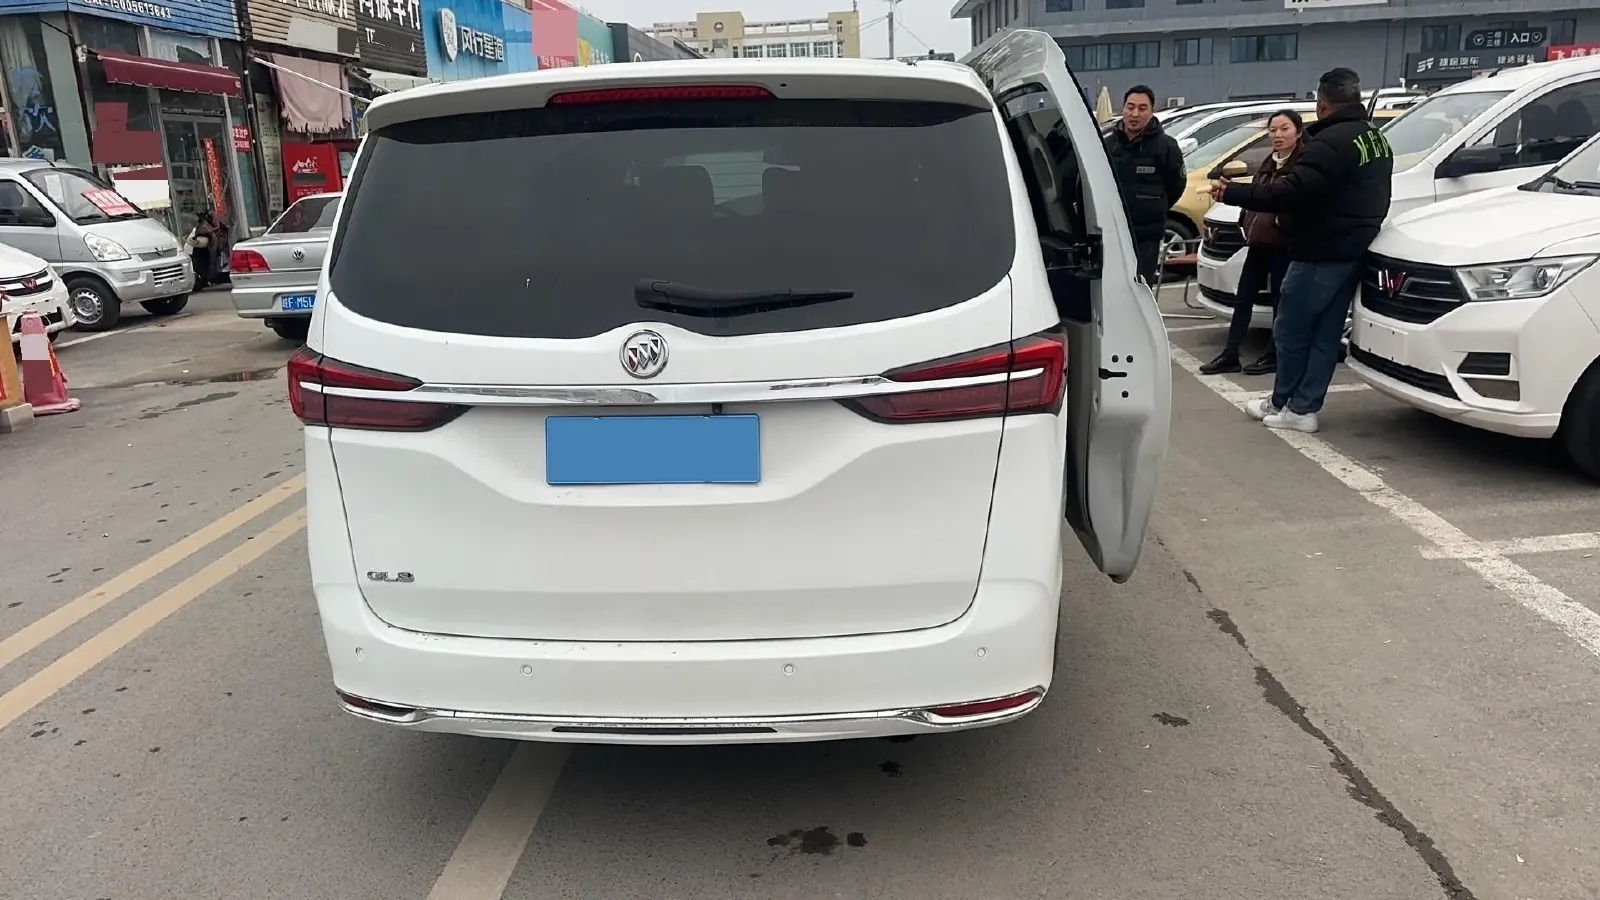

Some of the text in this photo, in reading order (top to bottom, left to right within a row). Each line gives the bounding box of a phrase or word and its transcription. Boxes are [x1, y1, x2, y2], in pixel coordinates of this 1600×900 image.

[1511, 32, 1530, 43] 入口
[461, 26, 504, 61] 风行星海
[367, 571, 414, 582] GL8
